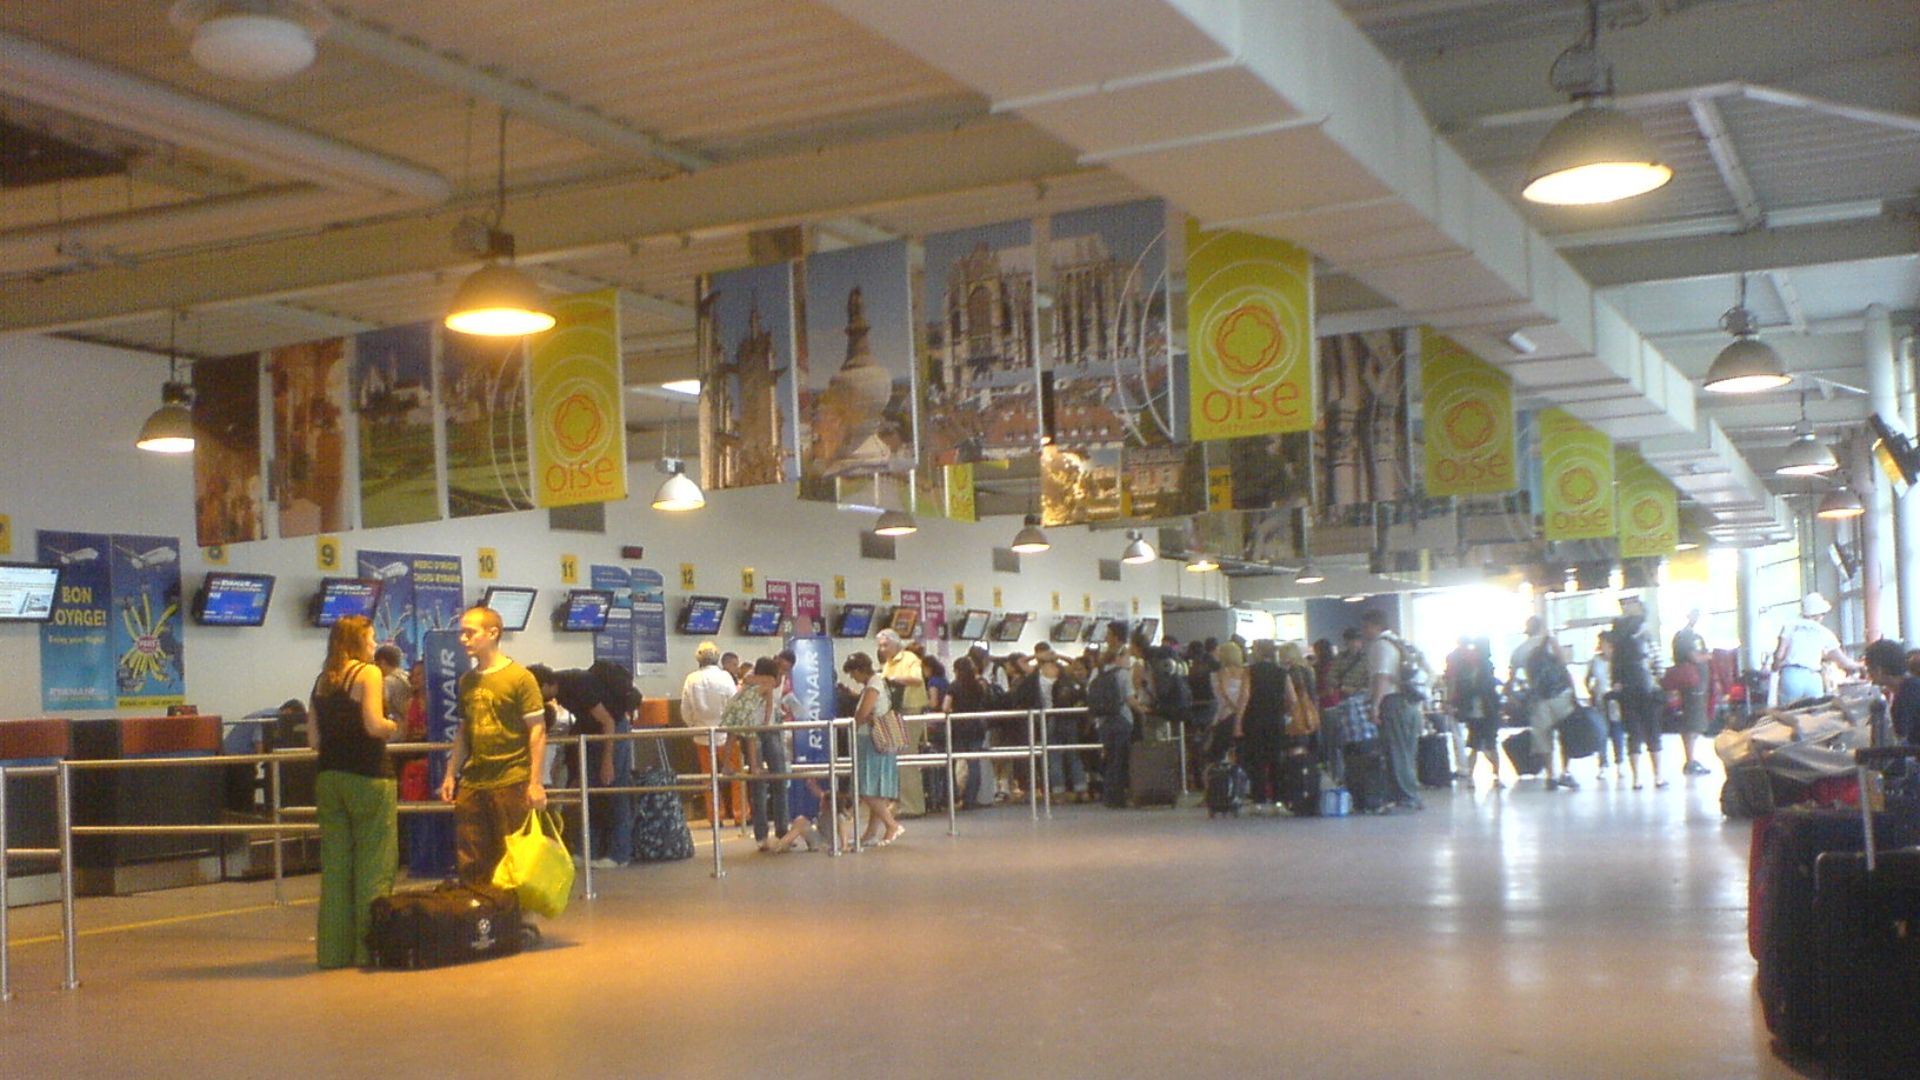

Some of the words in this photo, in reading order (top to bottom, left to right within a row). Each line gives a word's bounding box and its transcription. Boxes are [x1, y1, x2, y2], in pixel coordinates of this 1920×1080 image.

[1202, 381, 1299, 424] oise
[545, 457, 615, 493] oise
[1434, 455, 1508, 482] oise
[1552, 508, 1609, 529] oise
[321, 544, 335, 566] 9
[479, 555, 494, 573] 10
[562, 561, 574, 577] 11
[682, 568, 694, 584] 12
[62, 586, 92, 603] BON
[50, 609, 106, 626] OYAGE!
